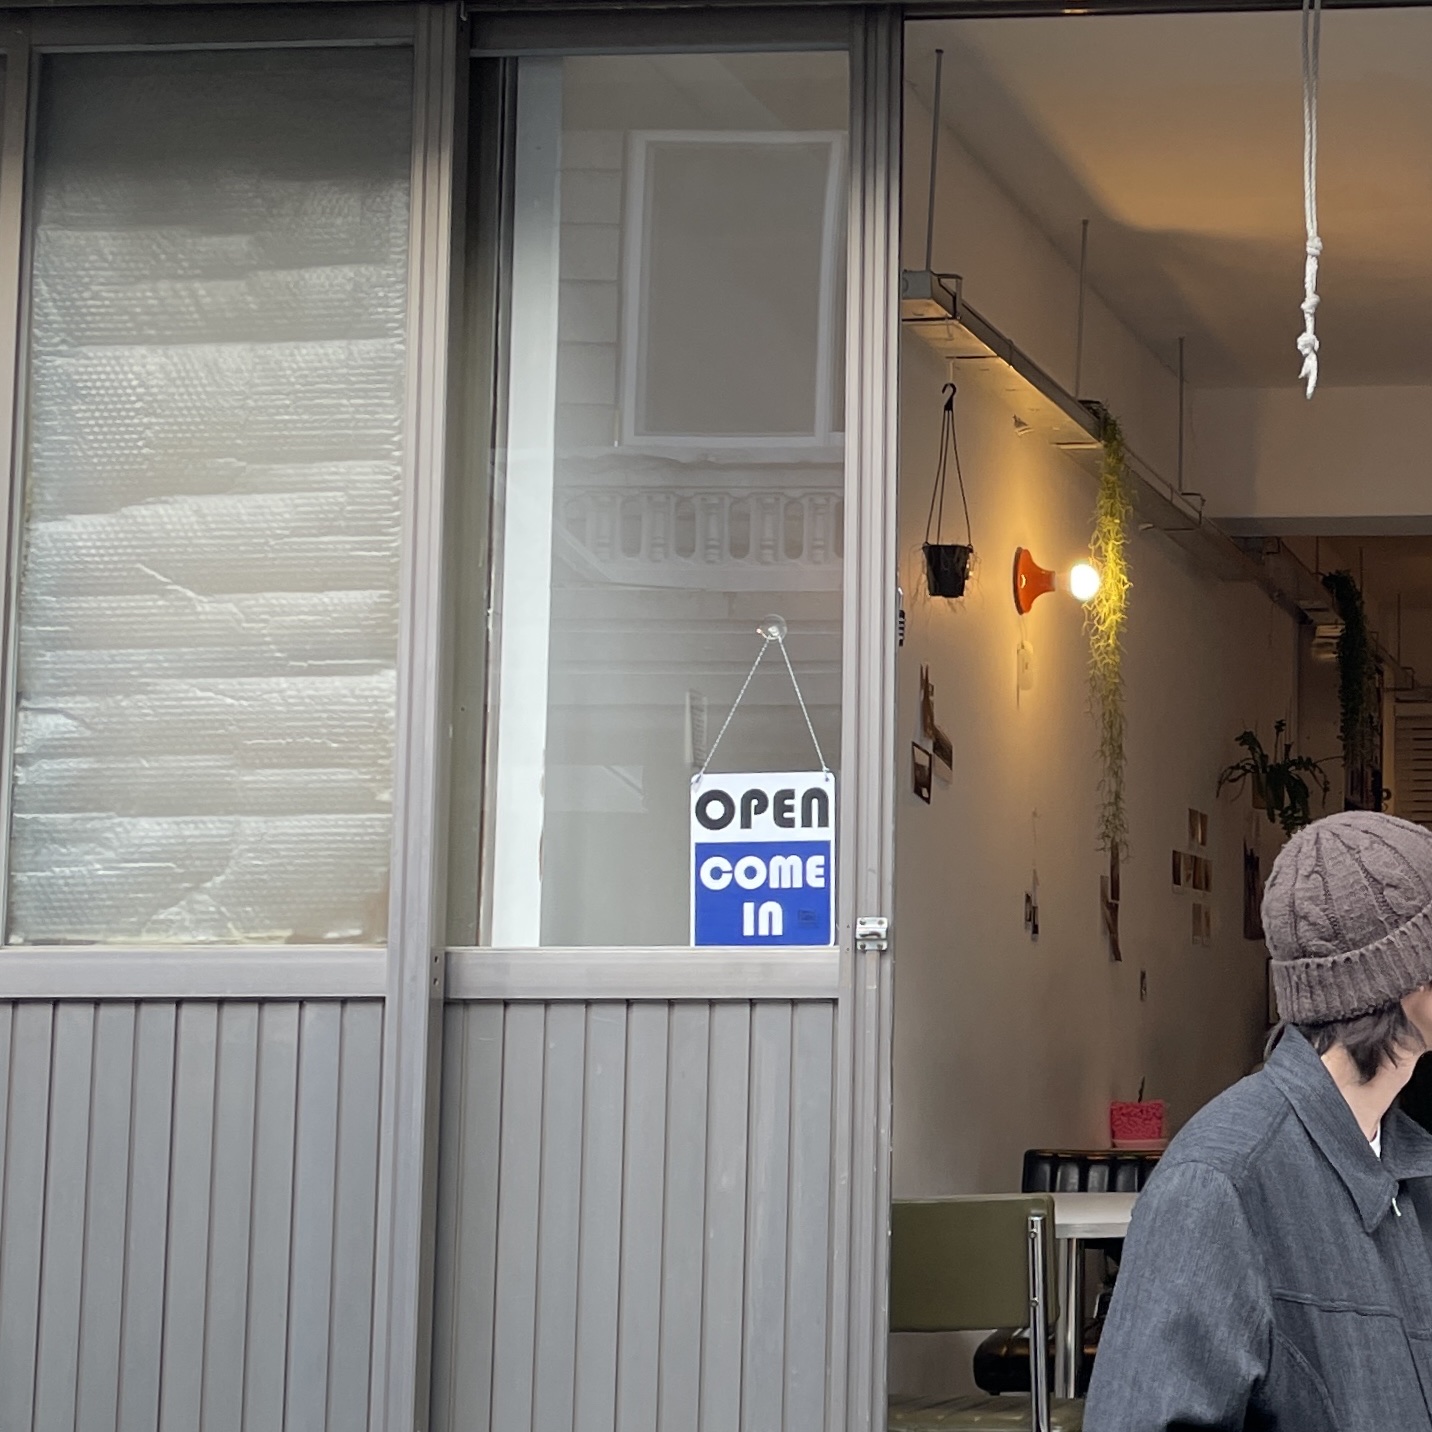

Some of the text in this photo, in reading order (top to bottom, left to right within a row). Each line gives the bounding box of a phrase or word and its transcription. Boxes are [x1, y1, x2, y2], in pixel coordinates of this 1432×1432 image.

[695, 787, 829, 830] OPEN
[700, 855, 825, 891] COME
[742, 901, 783, 936] IN
